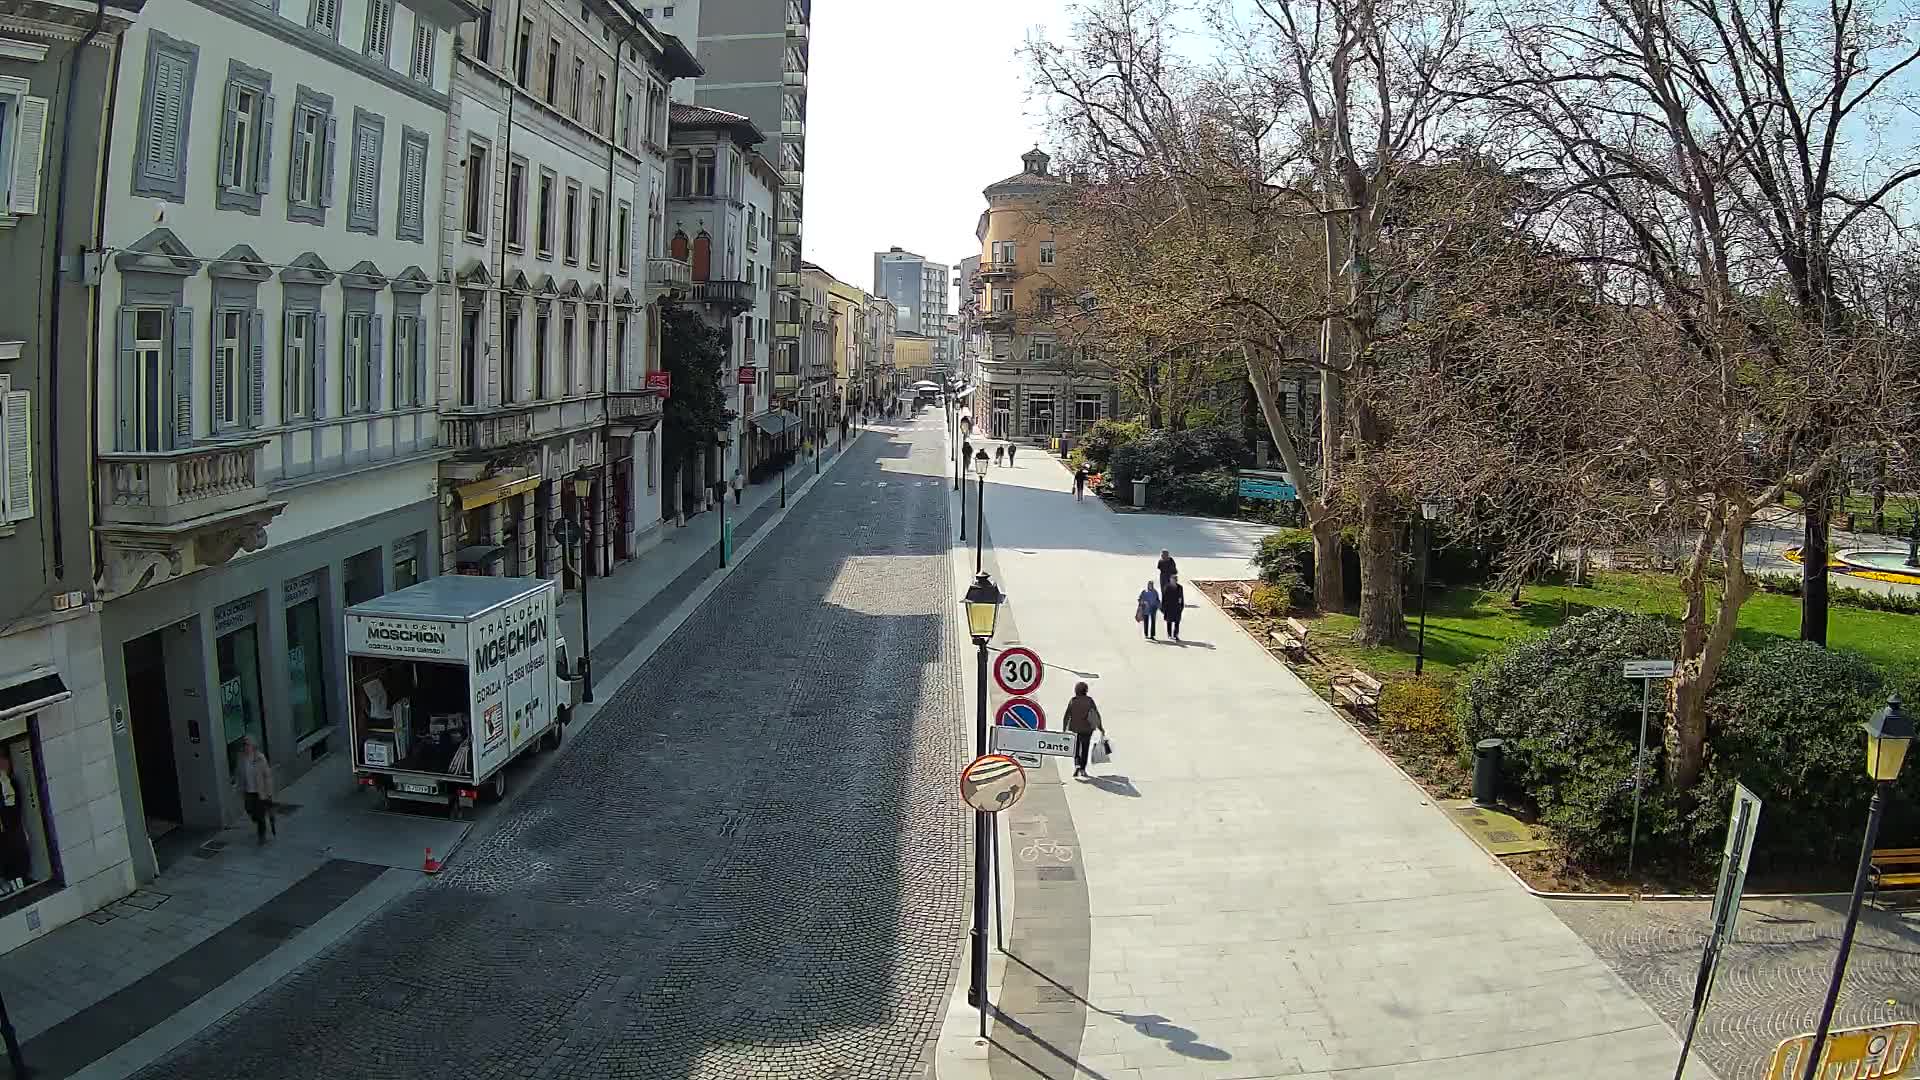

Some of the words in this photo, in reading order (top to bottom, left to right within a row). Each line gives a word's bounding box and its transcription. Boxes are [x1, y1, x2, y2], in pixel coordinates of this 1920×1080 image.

[480, 600, 544, 640] TRASLOCHI
[368, 626, 446, 644] MOSCHION
[475, 615, 547, 675] MOSCHION
[1005, 660, 1033, 683] 30
[1038, 740, 1070, 752] Dante
